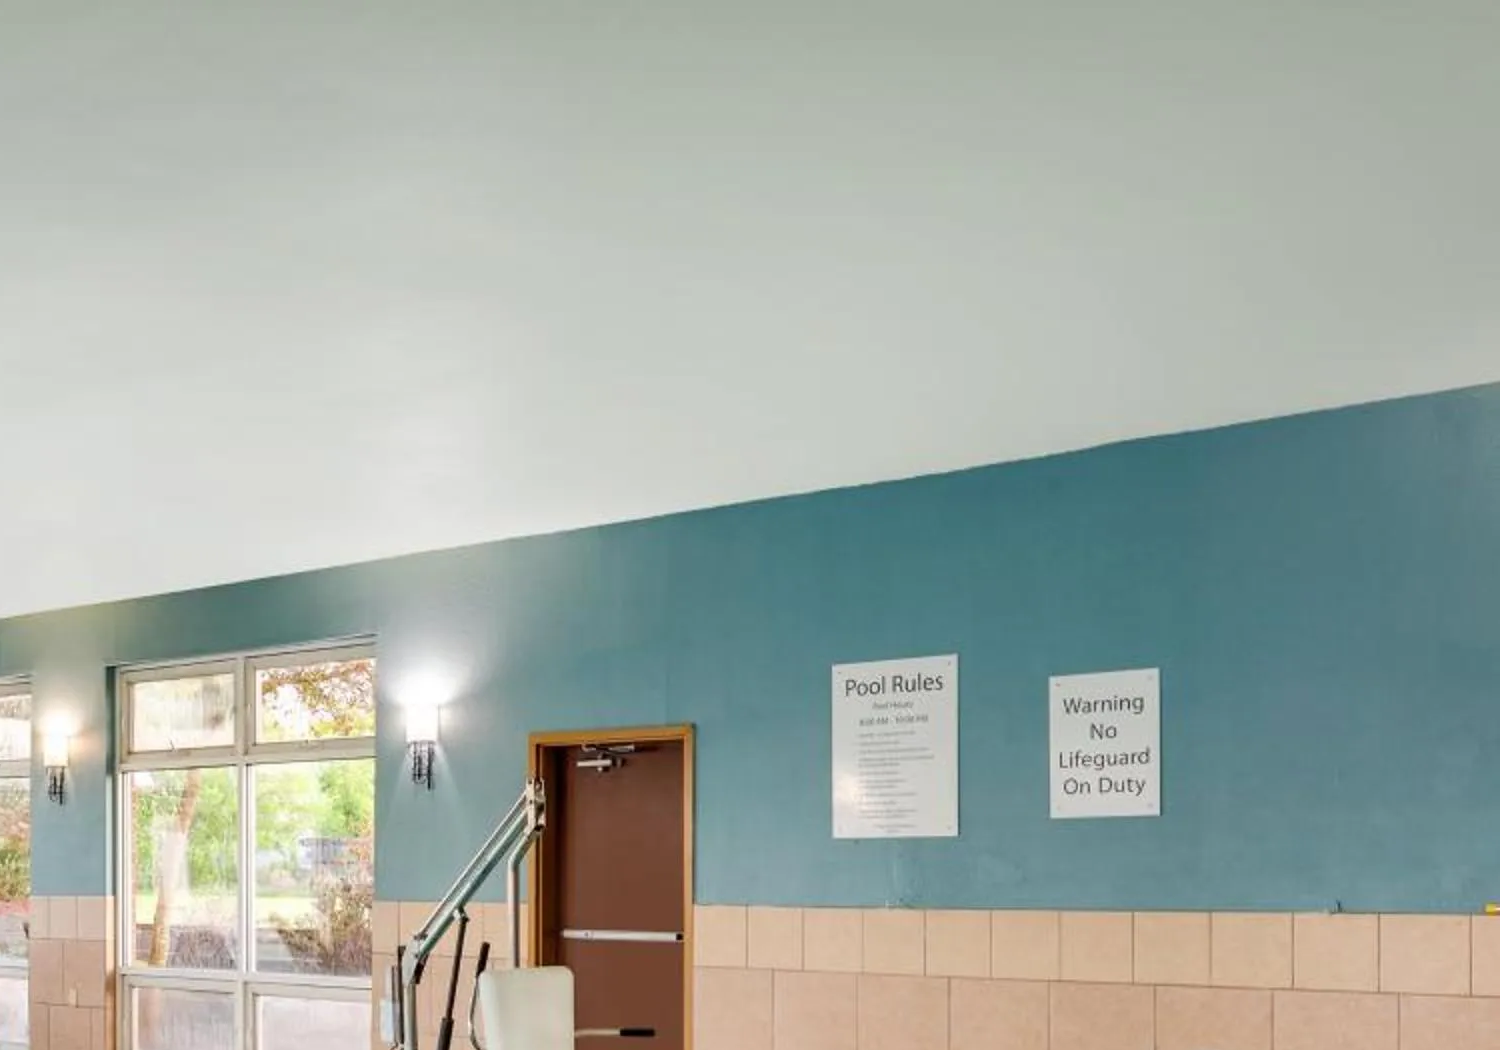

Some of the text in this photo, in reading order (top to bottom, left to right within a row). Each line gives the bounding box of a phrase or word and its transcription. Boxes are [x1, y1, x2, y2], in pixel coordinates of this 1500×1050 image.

[845, 672, 943, 696] Pool Rules
[1063, 696, 1145, 714] Warning
[1090, 723, 1117, 739] No
[1059, 745, 1150, 770] Lifeguard
[1063, 777, 1145, 796] On Duty
